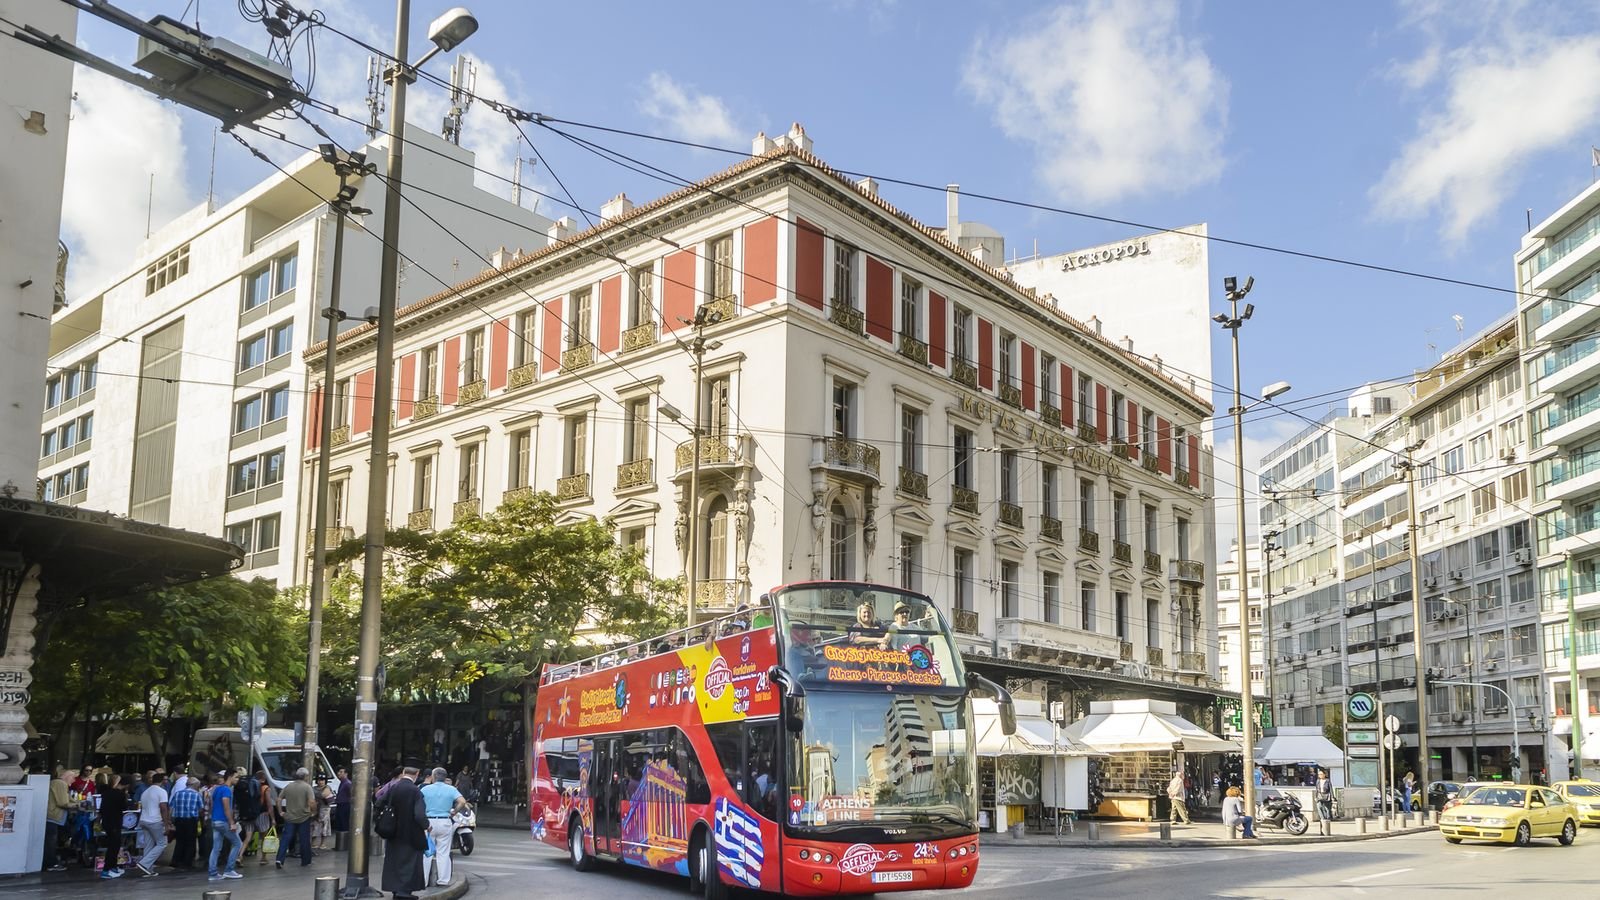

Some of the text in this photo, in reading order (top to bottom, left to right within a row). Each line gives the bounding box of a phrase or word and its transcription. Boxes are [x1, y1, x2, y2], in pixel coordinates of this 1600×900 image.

[1062, 241, 1151, 272] ACROPOL
[824, 645, 912, 665] CitySightseeing
[706, 670, 731, 688] OFFICIAL
[829, 667, 943, 685] Athens Piraeus Beaches
[793, 799, 801, 807] 10
[822, 798, 871, 809] ATHENS
[833, 811, 860, 821] LINE
[913, 842, 927, 858] 24
[842, 852, 882, 869] OFFICIAL
[856, 863, 873, 873] TOUR
